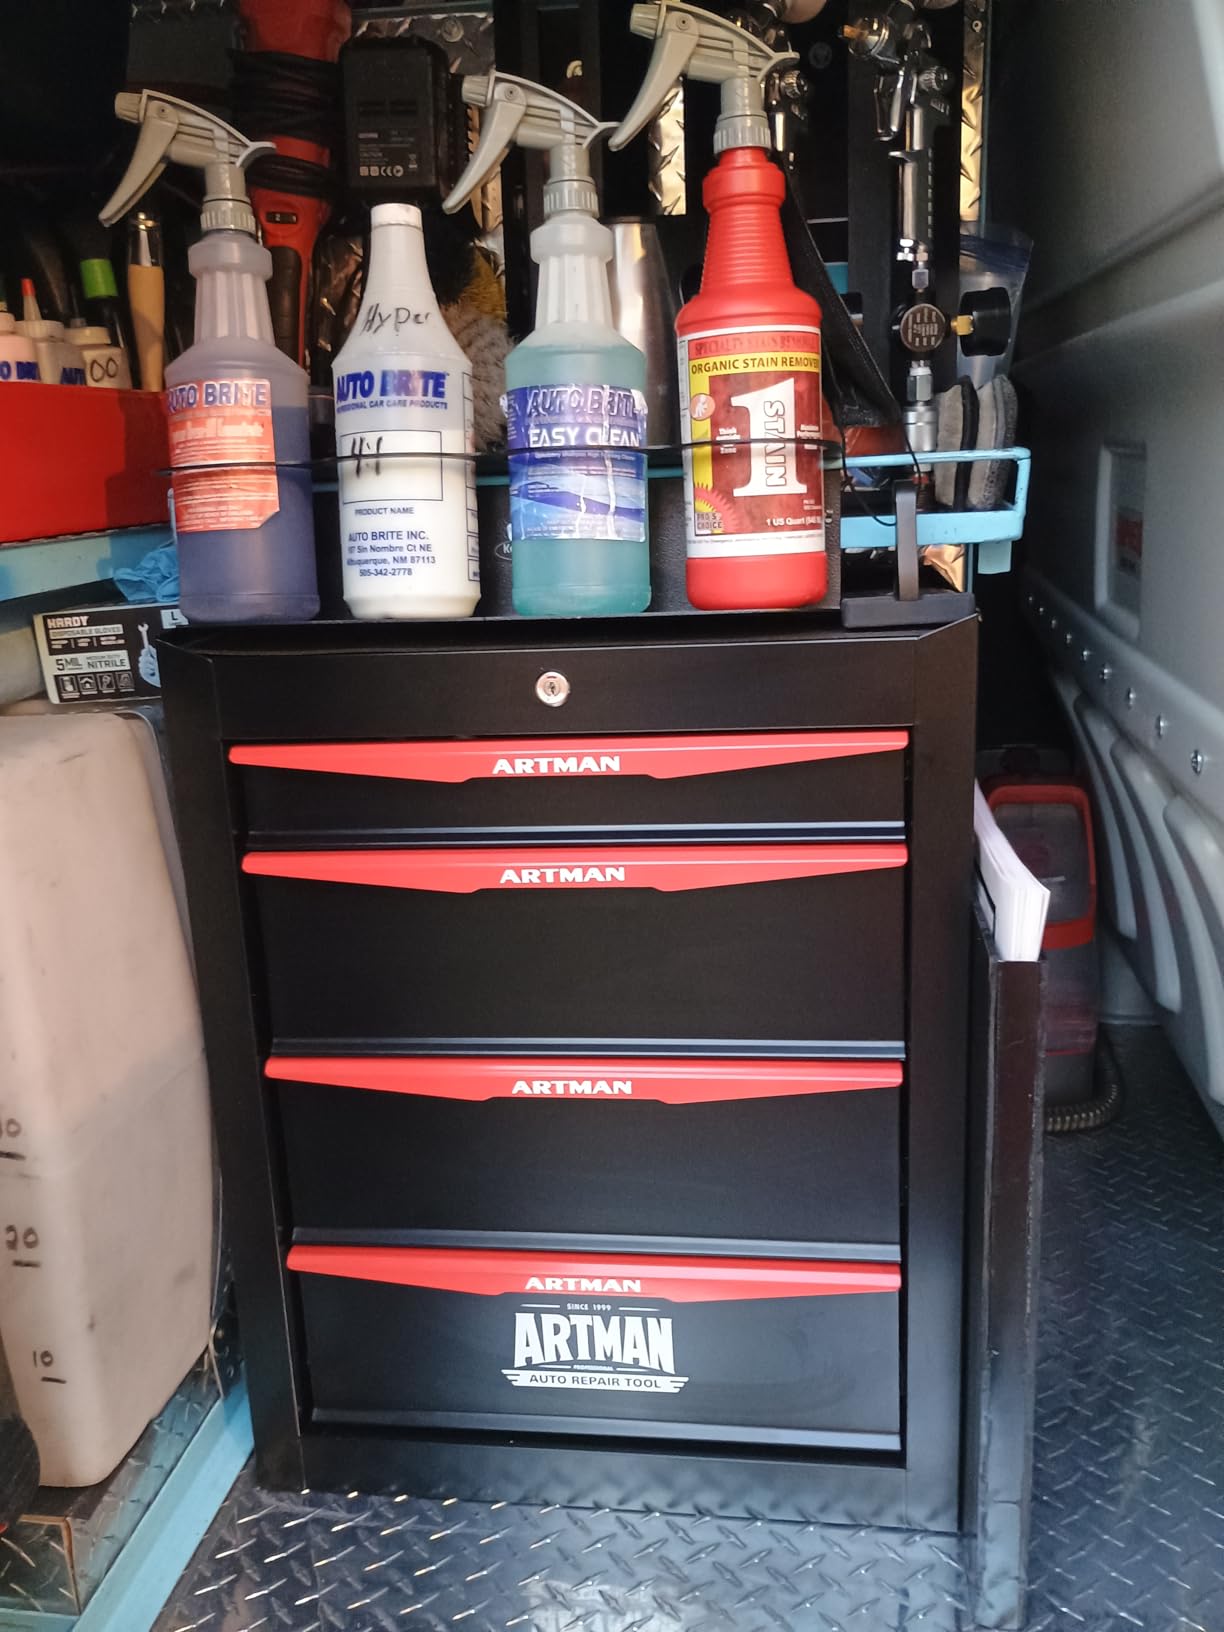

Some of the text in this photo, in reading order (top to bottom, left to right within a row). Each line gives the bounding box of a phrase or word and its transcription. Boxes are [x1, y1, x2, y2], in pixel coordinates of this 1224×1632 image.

[691, 358, 740, 375] ORGANIC
[742, 356, 778, 370] STAIN
[368, 400, 385, 409] CAR
[386, 399, 408, 408] CARE
[408, 400, 448, 410] PRODUCTS
[529, 426, 640, 448] EASY CLEAN
[730, 377, 808, 498] 1
[763, 400, 787, 487] STAIN
[355, 506, 415, 516] PRODUCT NAME
[772, 517, 785, 527] US
[348, 530, 430, 542] AUTO BRITE INC.
[369, 544, 404, 553] Nombre
[406, 543, 417, 552] Ct
[419, 543, 433, 552] NE
[392, 556, 408, 564] NM
[410, 555, 436, 564] 87113
[359, 567, 413, 577] 505-342-2778
[47, 615, 90, 629] HARDY
[55, 658, 65, 672] 5
[87, 658, 127, 670] NITRILE
[492, 755, 621, 775] ARTMAN
[499, 866, 626, 884] ARTMAN
[511, 1079, 633, 1095] ARTMAN
[0, 1118, 21, 1138] 0
[524, 1276, 642, 1293] ARTMAN
[566, 1303, 612, 1312] SINCE 1999
[513, 1312, 676, 1375] ARTMAN
[529, 1374, 662, 1389] AUTO REPAIR TOOL
